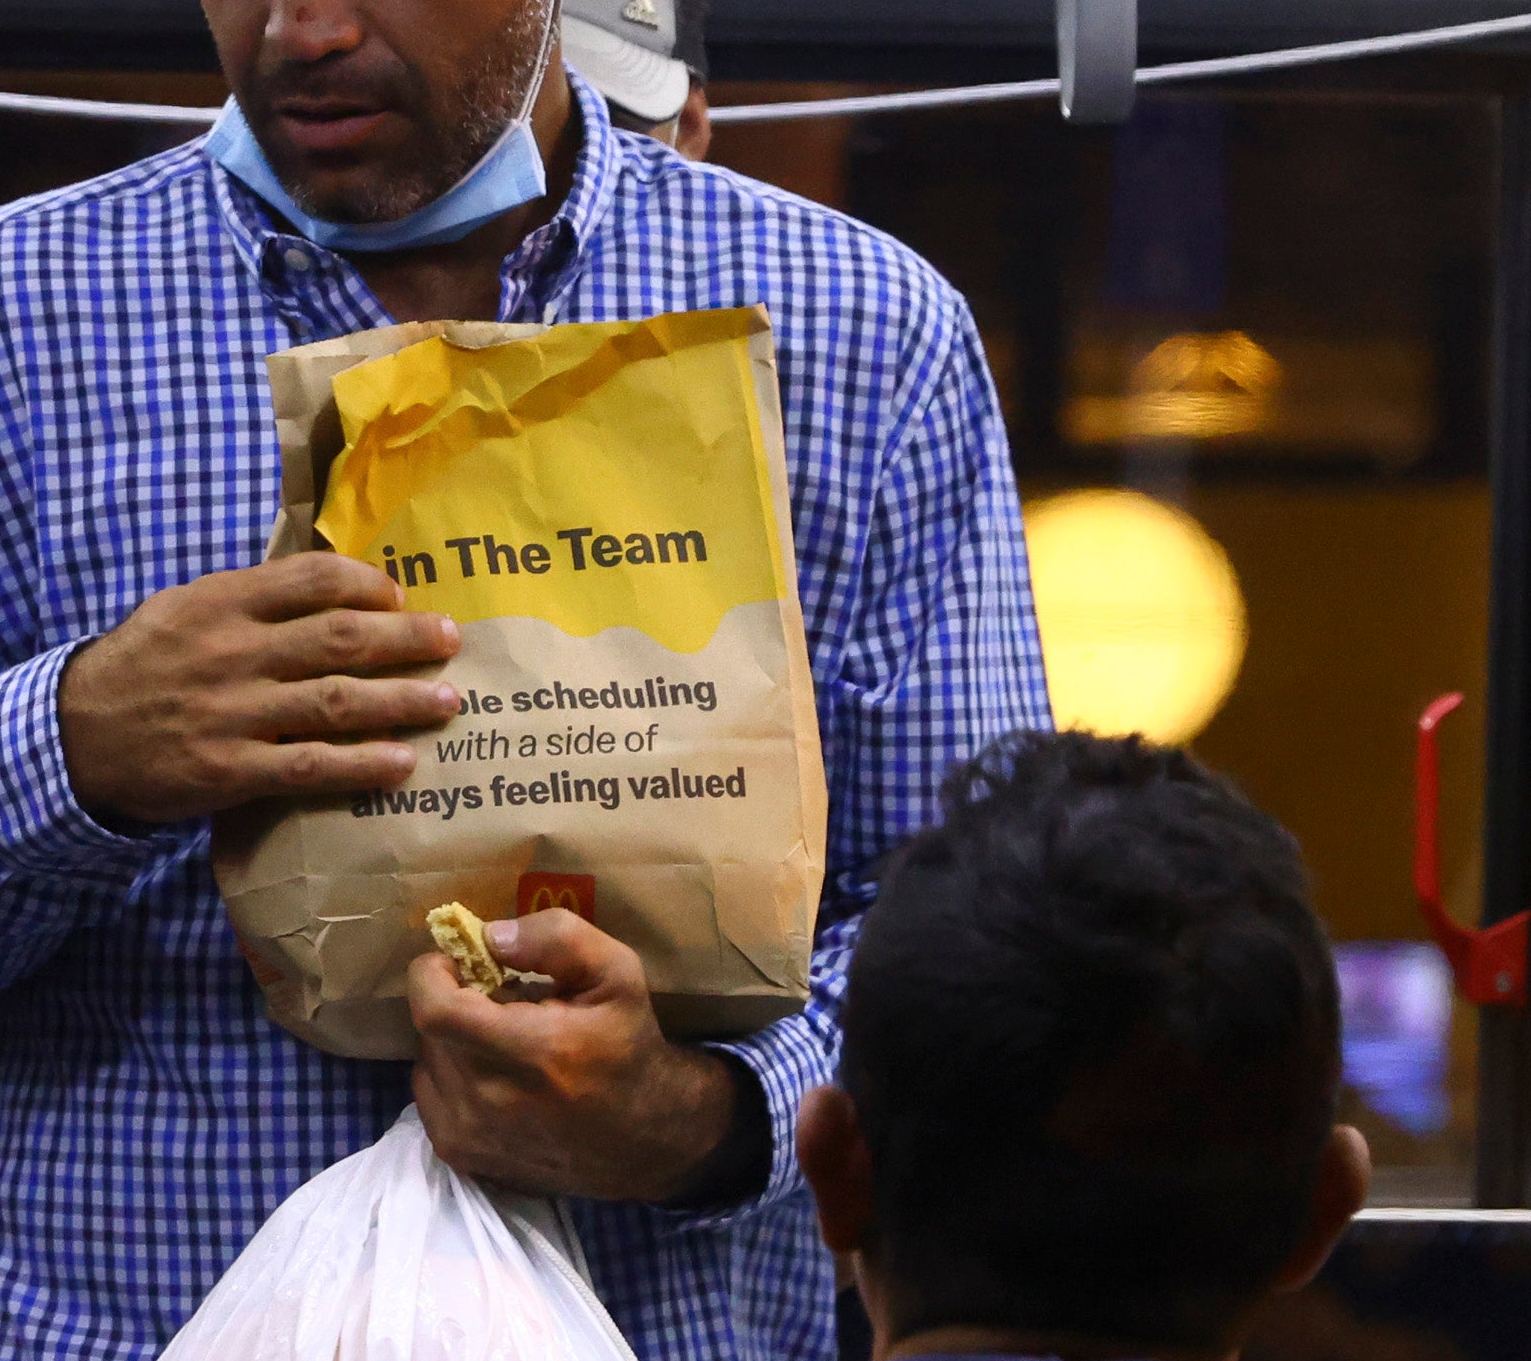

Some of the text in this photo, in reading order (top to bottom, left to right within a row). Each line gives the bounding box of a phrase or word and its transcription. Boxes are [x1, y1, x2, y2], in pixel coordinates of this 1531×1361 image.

[445, 534, 552, 578] The
[556, 526, 708, 571] Team
[511, 675, 718, 713] scheduling
[436, 722, 660, 764] with a side of
[350, 766, 747, 821] always feeling valued
